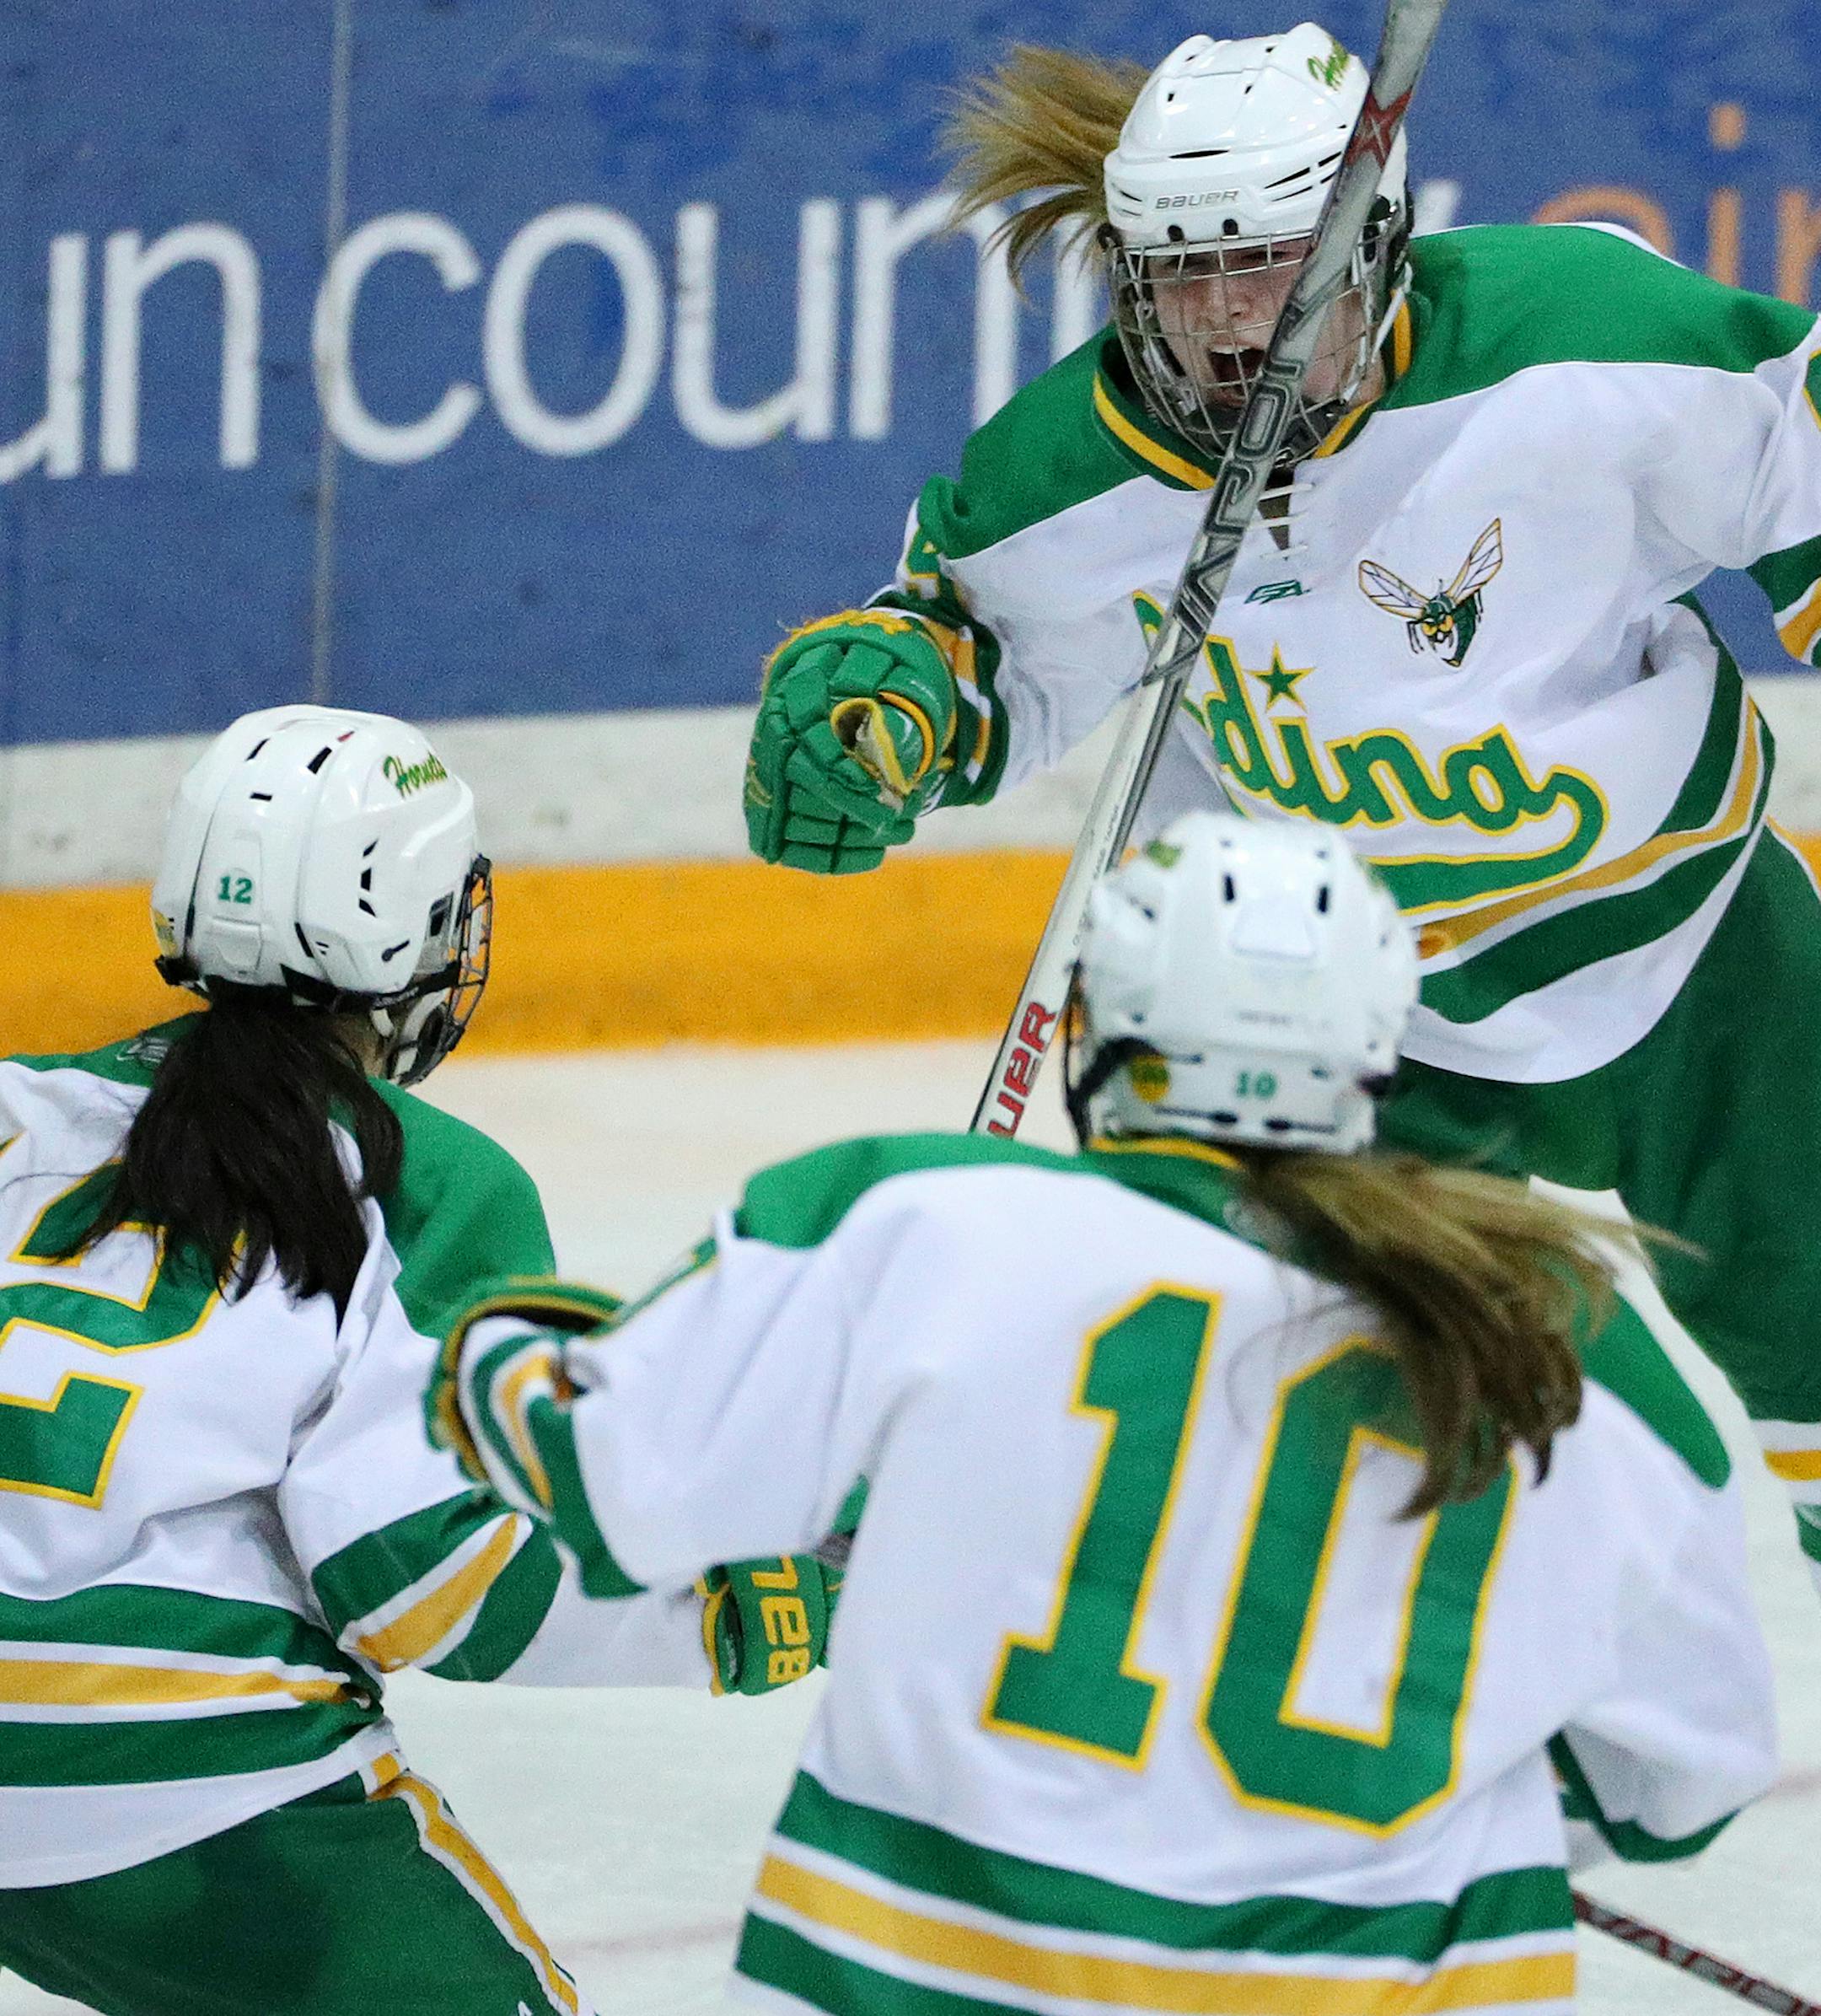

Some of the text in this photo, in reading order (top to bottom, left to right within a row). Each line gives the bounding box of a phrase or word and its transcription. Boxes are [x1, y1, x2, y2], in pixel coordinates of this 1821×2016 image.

[1131, 589, 1575, 838] dina
[217, 875, 255, 904] 12
[1235, 1070, 1278, 1099] 10
[979, 1279, 1519, 1841] 10
